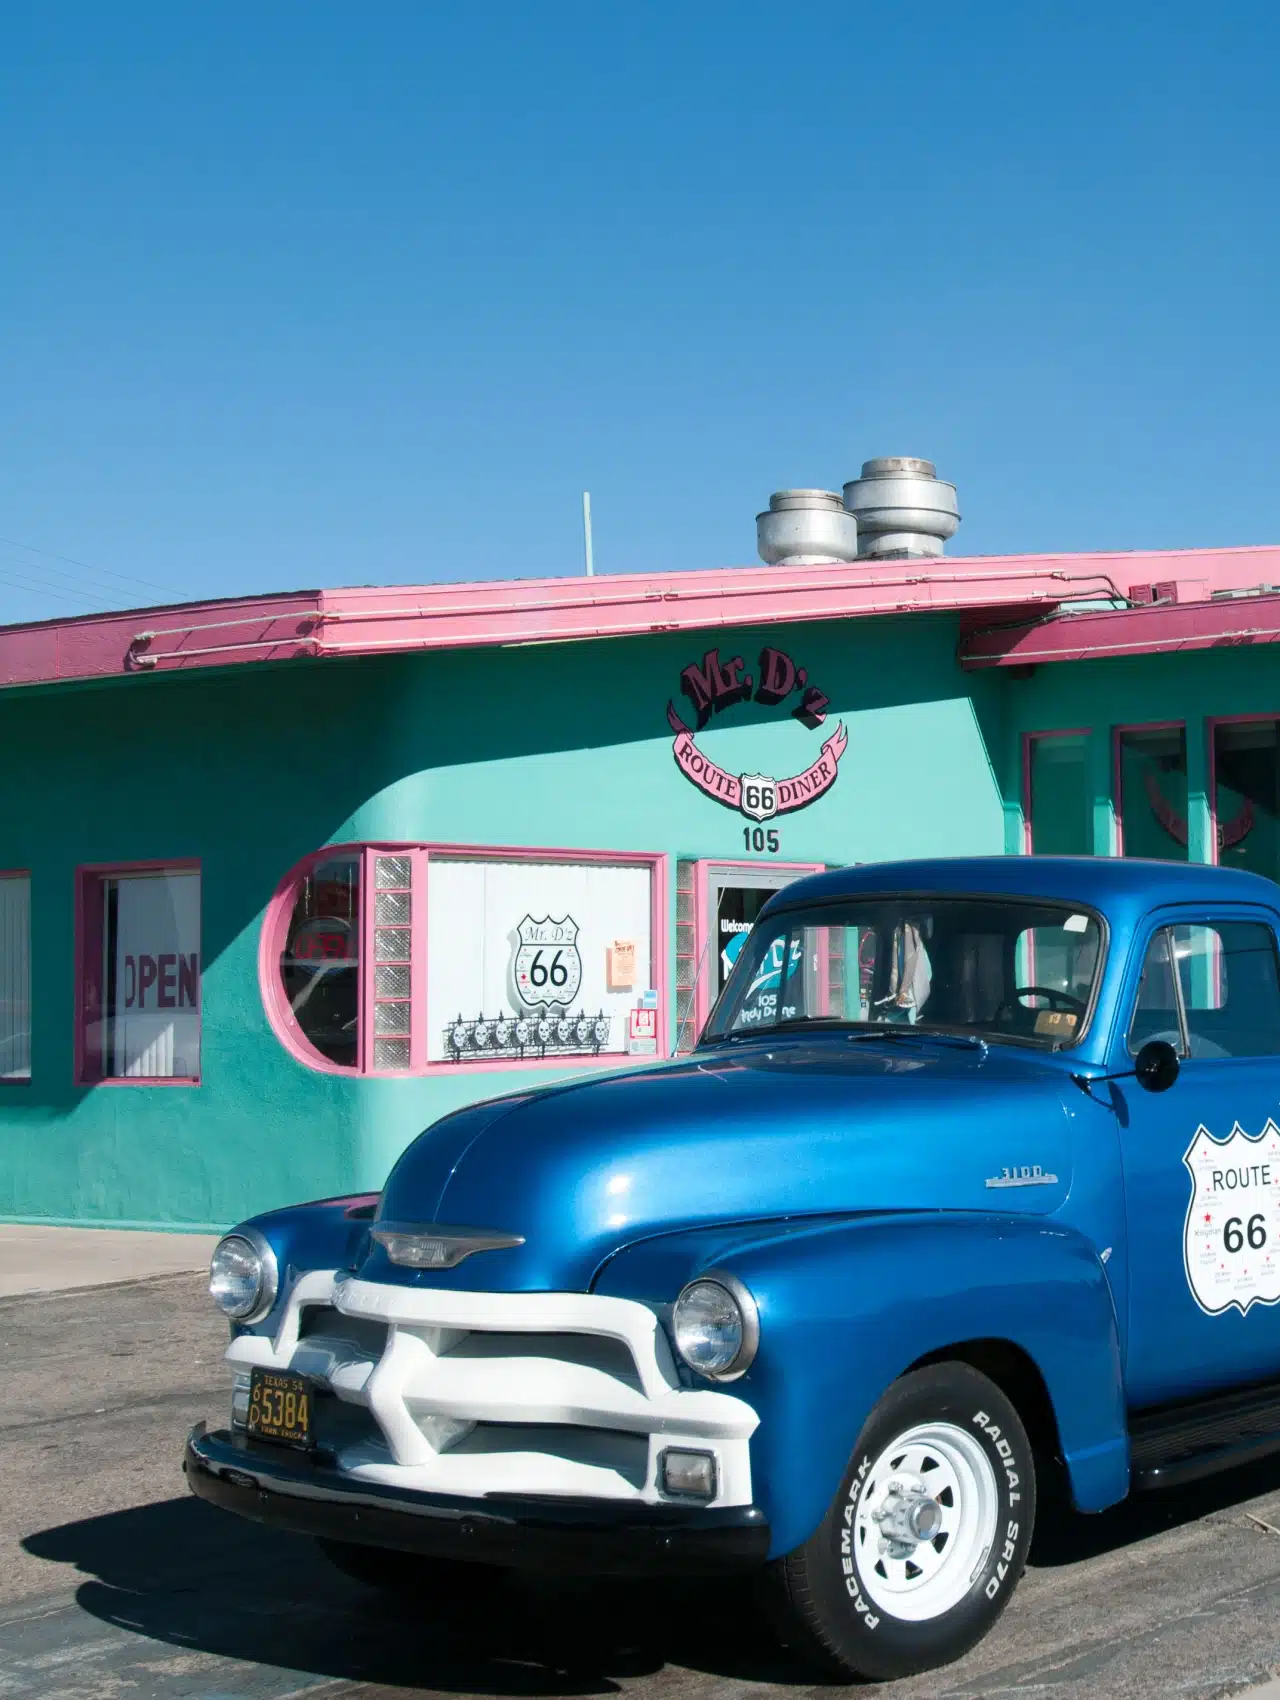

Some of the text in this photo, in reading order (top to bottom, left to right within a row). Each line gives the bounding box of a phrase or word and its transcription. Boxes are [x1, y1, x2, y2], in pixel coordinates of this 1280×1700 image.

[680, 648, 753, 714] Mr.
[678, 741, 832, 810] ROUTE 66 DINER
[743, 827, 780, 853] 105
[525, 926, 548, 941] Mr.
[530, 950, 568, 987] 66
[758, 994, 777, 1007] 105
[1002, 1165, 1042, 1179] 3100
[1212, 1165, 1271, 1192] ROUTE
[1223, 1213, 1267, 1253] 66
[264, 1375, 304, 1391] TEXAS 54
[261, 1389, 308, 1432] 5384
[972, 1410, 1021, 1599] RADIAL SR70
[841, 1455, 880, 1630] PACEMARK
